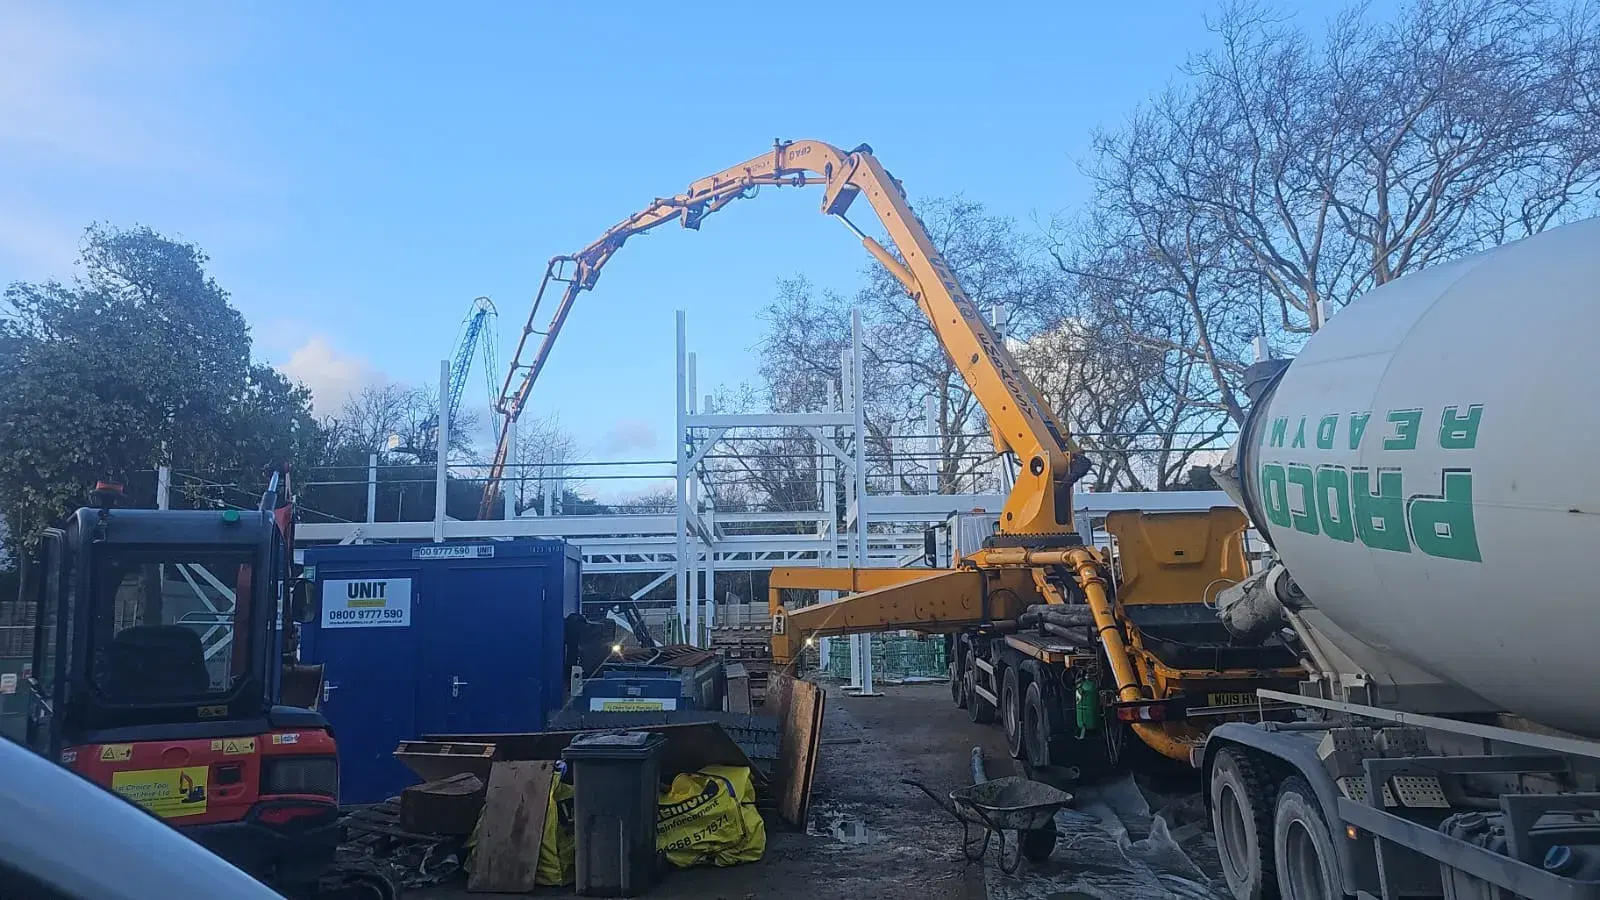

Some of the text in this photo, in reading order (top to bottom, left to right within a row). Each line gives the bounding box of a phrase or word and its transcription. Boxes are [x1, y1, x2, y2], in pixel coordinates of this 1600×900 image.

[978, 332, 1034, 420] EMBASSY
[1260, 462, 1482, 563] PROCO
[347, 582, 386, 599] UNIT
[329, 609, 403, 620] 0800 9777 590
[657, 799, 720, 834] einforcement
[693, 814, 729, 841] 571571
